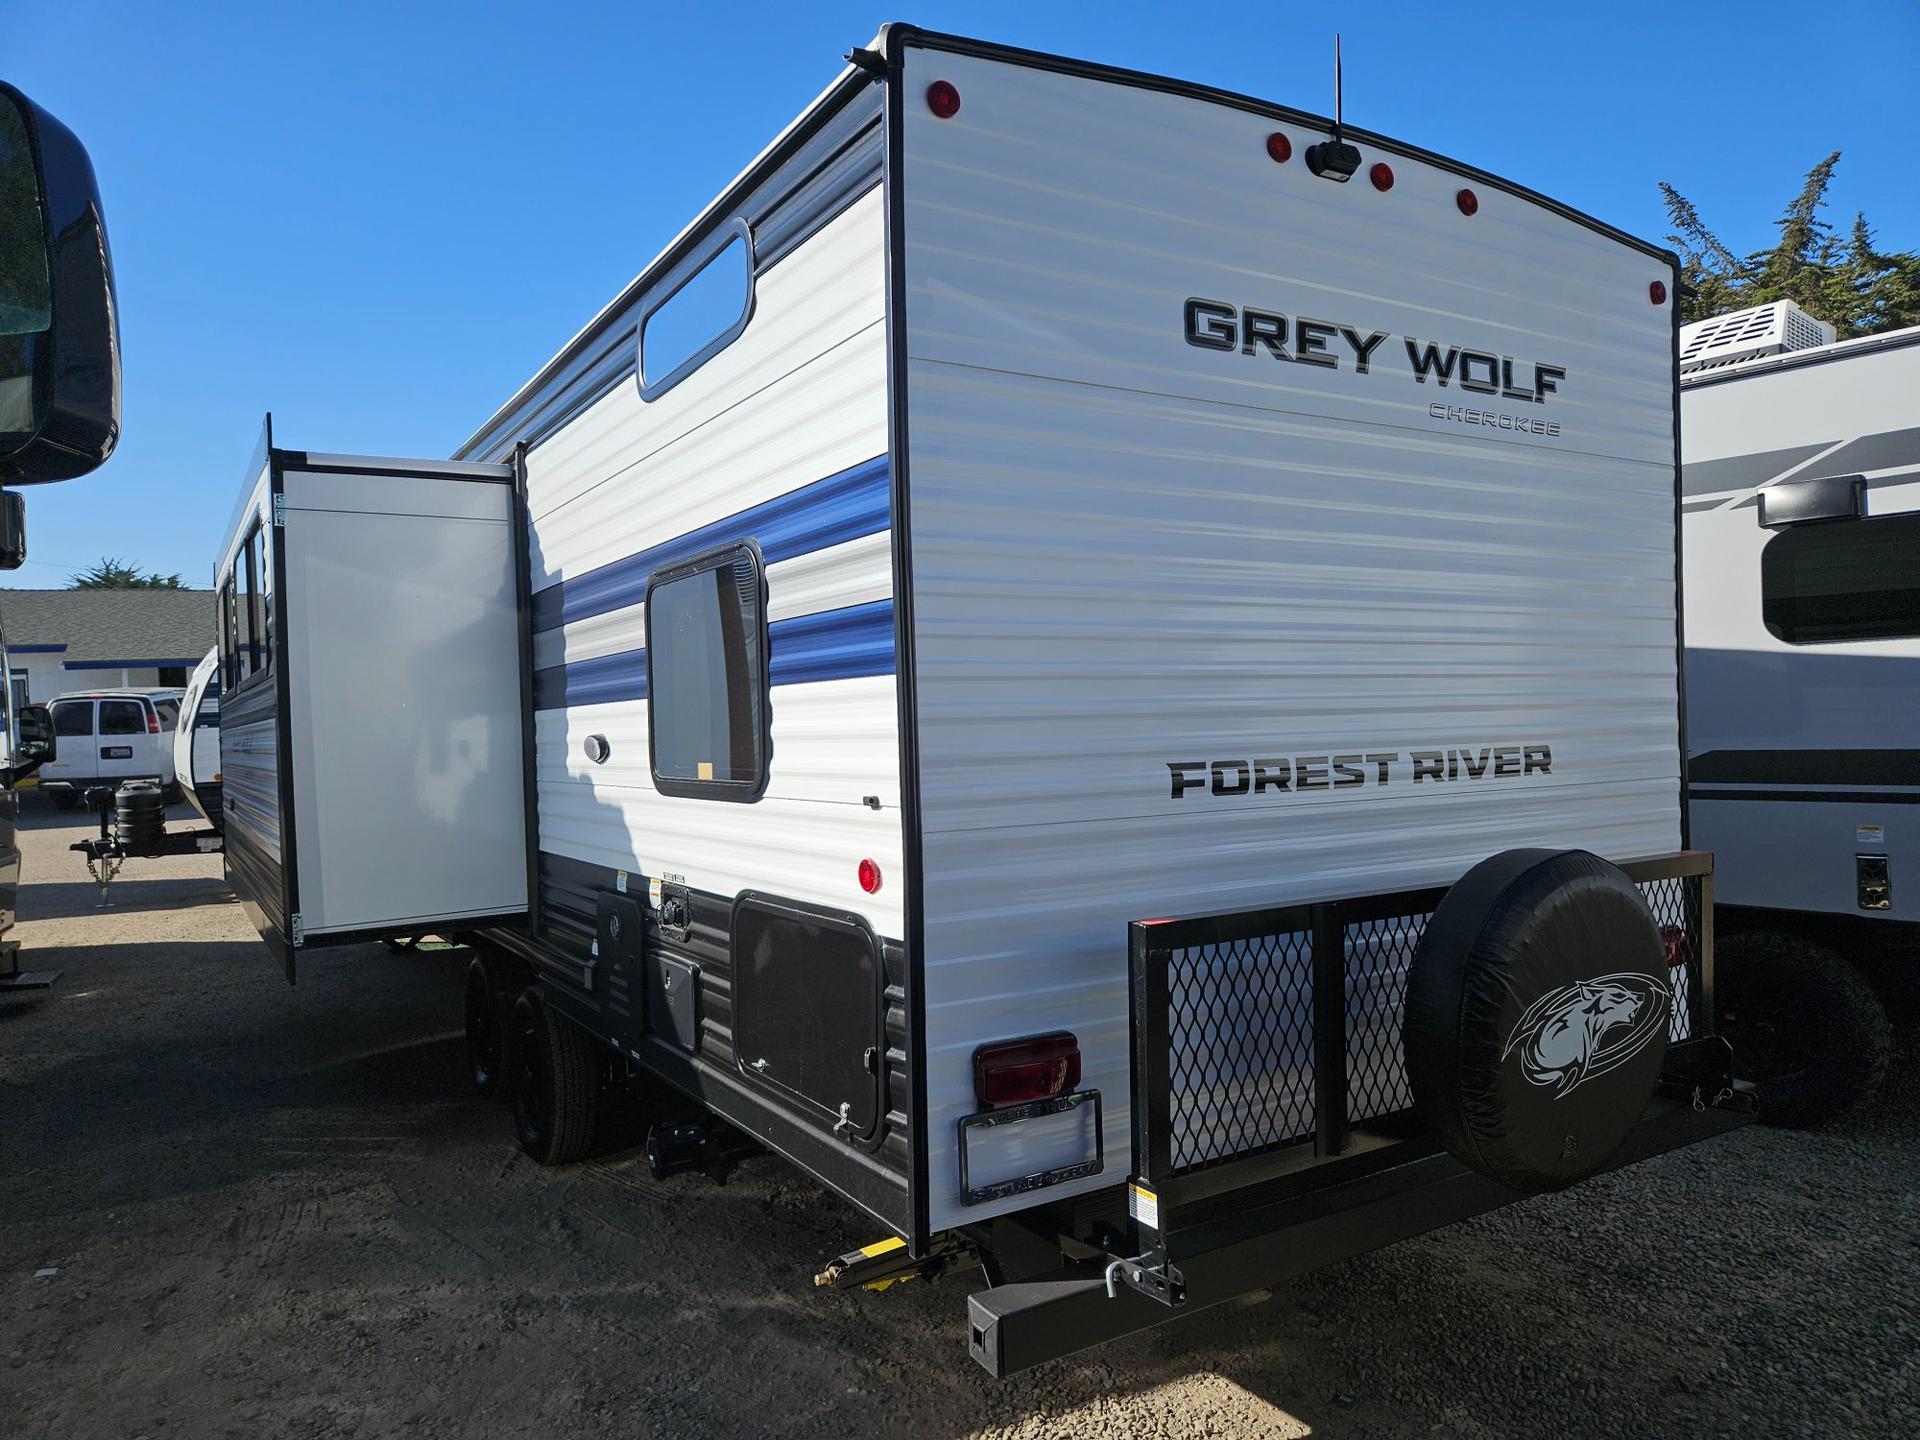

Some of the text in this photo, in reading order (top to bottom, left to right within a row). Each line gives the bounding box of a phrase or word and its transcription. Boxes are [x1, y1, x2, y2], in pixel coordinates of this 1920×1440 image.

[1184, 297, 1566, 403] GREY WOLF
[1429, 403, 1561, 437] CHEROKEE
[1166, 744, 1552, 799] FOREST RIVER
